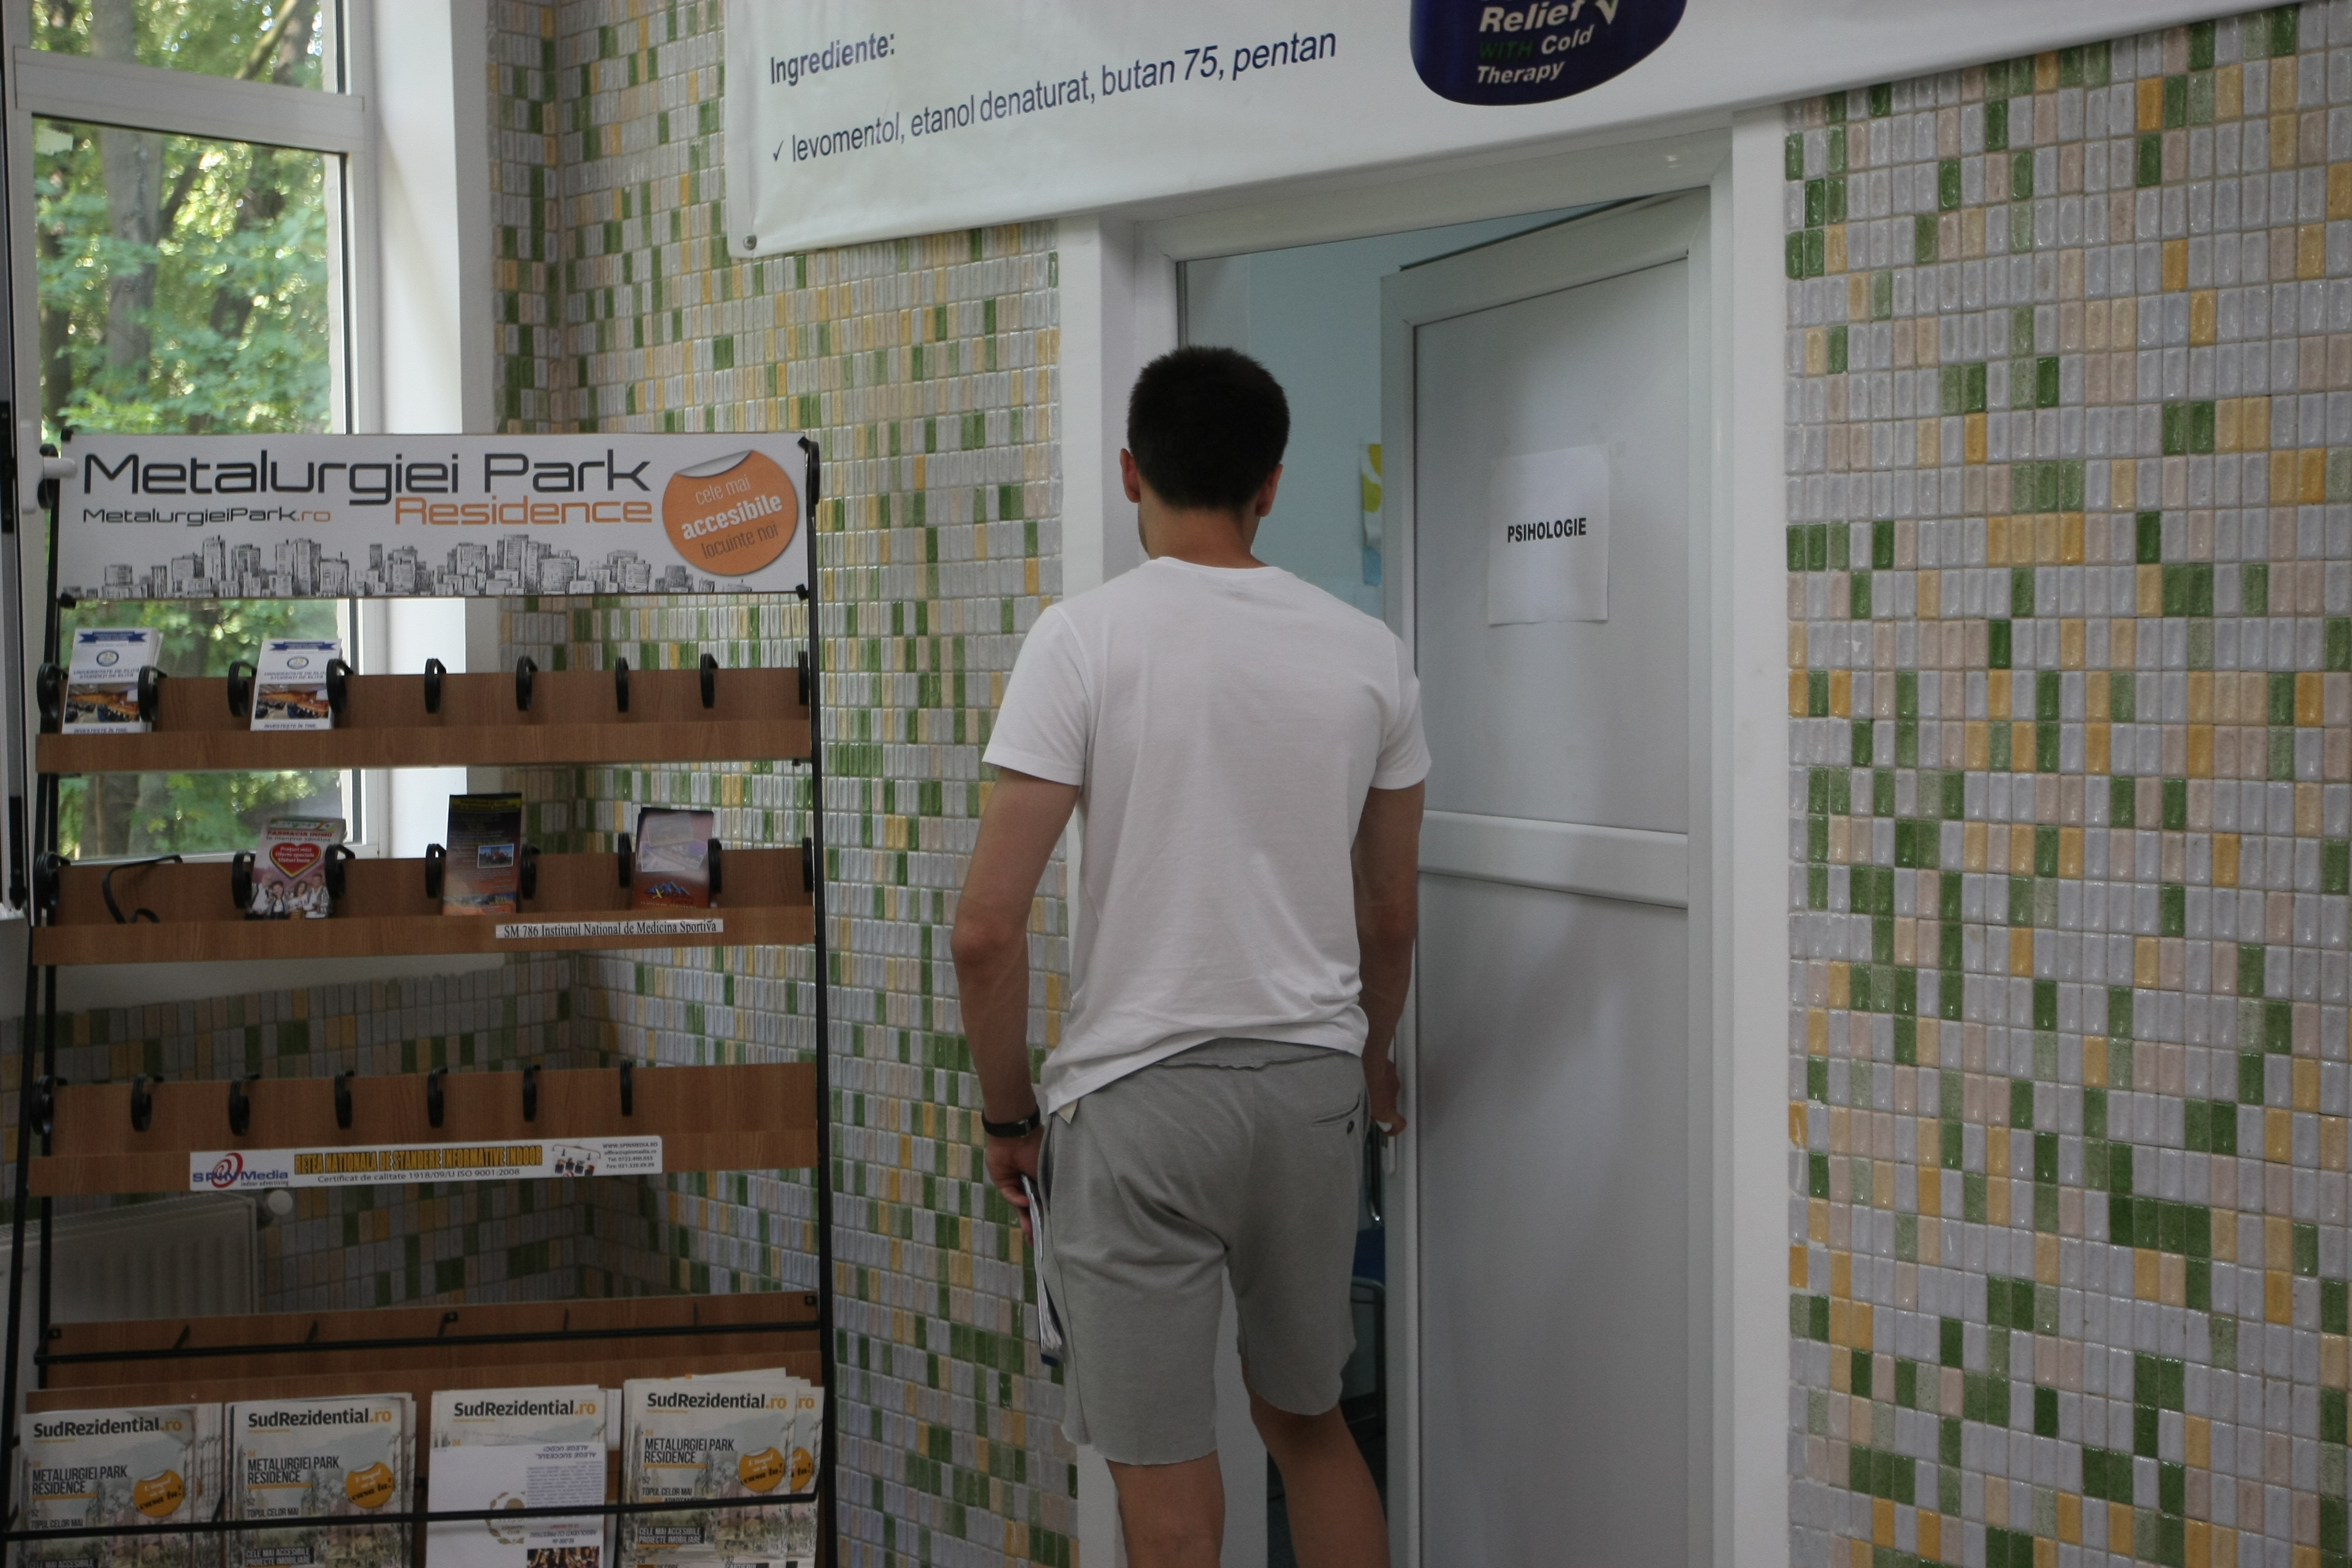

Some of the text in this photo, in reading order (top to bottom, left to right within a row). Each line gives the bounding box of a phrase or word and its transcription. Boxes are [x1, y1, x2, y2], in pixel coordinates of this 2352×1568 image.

[1479, 0, 1586, 33] Relief
[1480, 24, 1594, 59] WITH Cold
[770, 33, 895, 87] Ingrediente:
[1478, 62, 1566, 84] Therapy
[791, 31, 1336, 162] levomentol, etanol denaturat, butan 75, pentan
[83, 449, 653, 506] Metalurgiei Park
[695, 474, 751, 506] cele mai
[83, 508, 331, 528] MetalurgieiPark.ro
[394, 498, 653, 526] Residence
[681, 494, 783, 540] accesibile
[757, 521, 779, 542] noi
[1508, 517, 1587, 543] PSIHOLOGIE
[504, 926, 519, 938] SM
[523, 925, 538, 938] 786
[542, 923, 581, 936] Institutul
[584, 921, 621, 935] National
[624, 921, 634, 934] de
[638, 920, 677, 933] Medicina
[325, 1151, 378, 1174] NATIONALA
[379, 1151, 392, 1172] DE
[442, 1147, 505, 1169] INFORMATIVE
[506, 1145, 543, 1167] INDOOR
[192, 1169, 289, 1183] SPIN Media
[318, 1174, 358, 1183] Certificat
[374, 1172, 406, 1181] calitate
[410, 1171, 454, 1180] 1918/09/U
[454, 1399, 597, 1417] SudRezidential.ro
[647, 1391, 787, 1410] SudRezidential.ro
[34, 1416, 183, 1438] SudRezidential.ro
[248, 1407, 393, 1428] SudRezidential.ro
[644, 1438, 734, 1452] METALURGIEI PARK
[247, 1456, 340, 1473] METALURGIEI PARK
[644, 1451, 696, 1465] RESIDENCE
[32, 1465, 128, 1483] METALURGIEI PARK
[247, 1469, 301, 1485] RESIDENCE
[32, 1480, 86, 1495] RESIDENCE
[642, 1488, 660, 1496] TOPUL
[661, 1488, 680, 1496] CELOR
[247, 1507, 299, 1518] TOPUL CELOR MAI
[50, 1518, 70, 1528] CELOR
[71, 1518, 83, 1527] MAI
